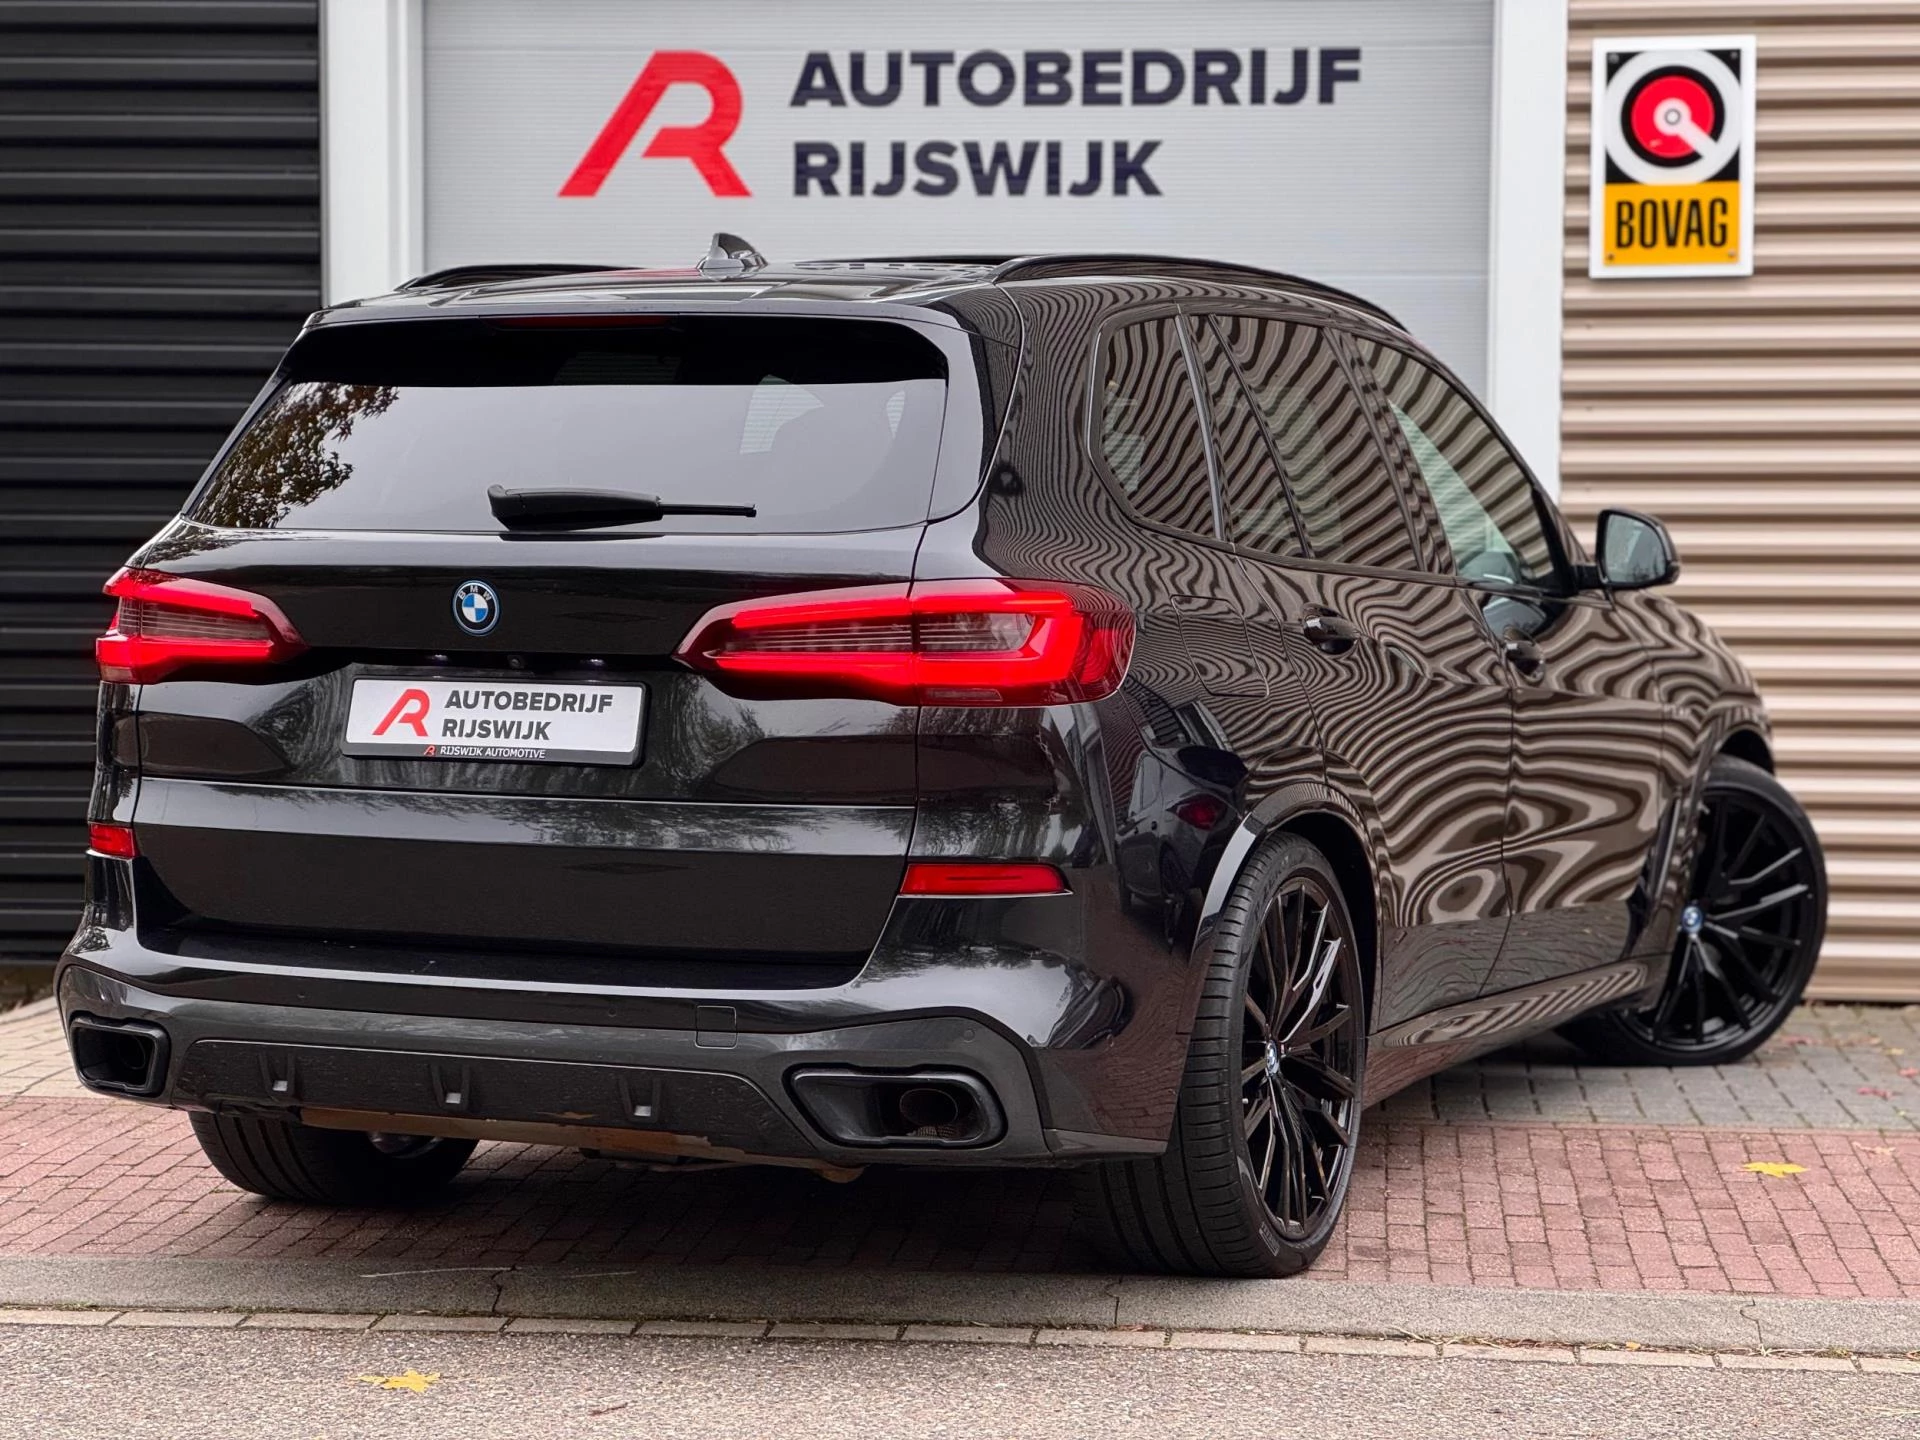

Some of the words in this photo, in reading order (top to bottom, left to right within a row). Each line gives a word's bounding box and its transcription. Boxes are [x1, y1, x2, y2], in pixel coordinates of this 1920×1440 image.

[790, 47, 1362, 107] AUTOBEDRIJF
[792, 140, 1164, 197] RIJSWIJK
[1616, 198, 1728, 248] BOVAG
[457, 585, 492, 601] BMW
[444, 690, 613, 713] AUTOBEDRIJF
[441, 719, 552, 741] RIJSWIJK
[440, 746, 483, 757] RIJSWIJK
[484, 747, 546, 759] AUTOMOTIVE
